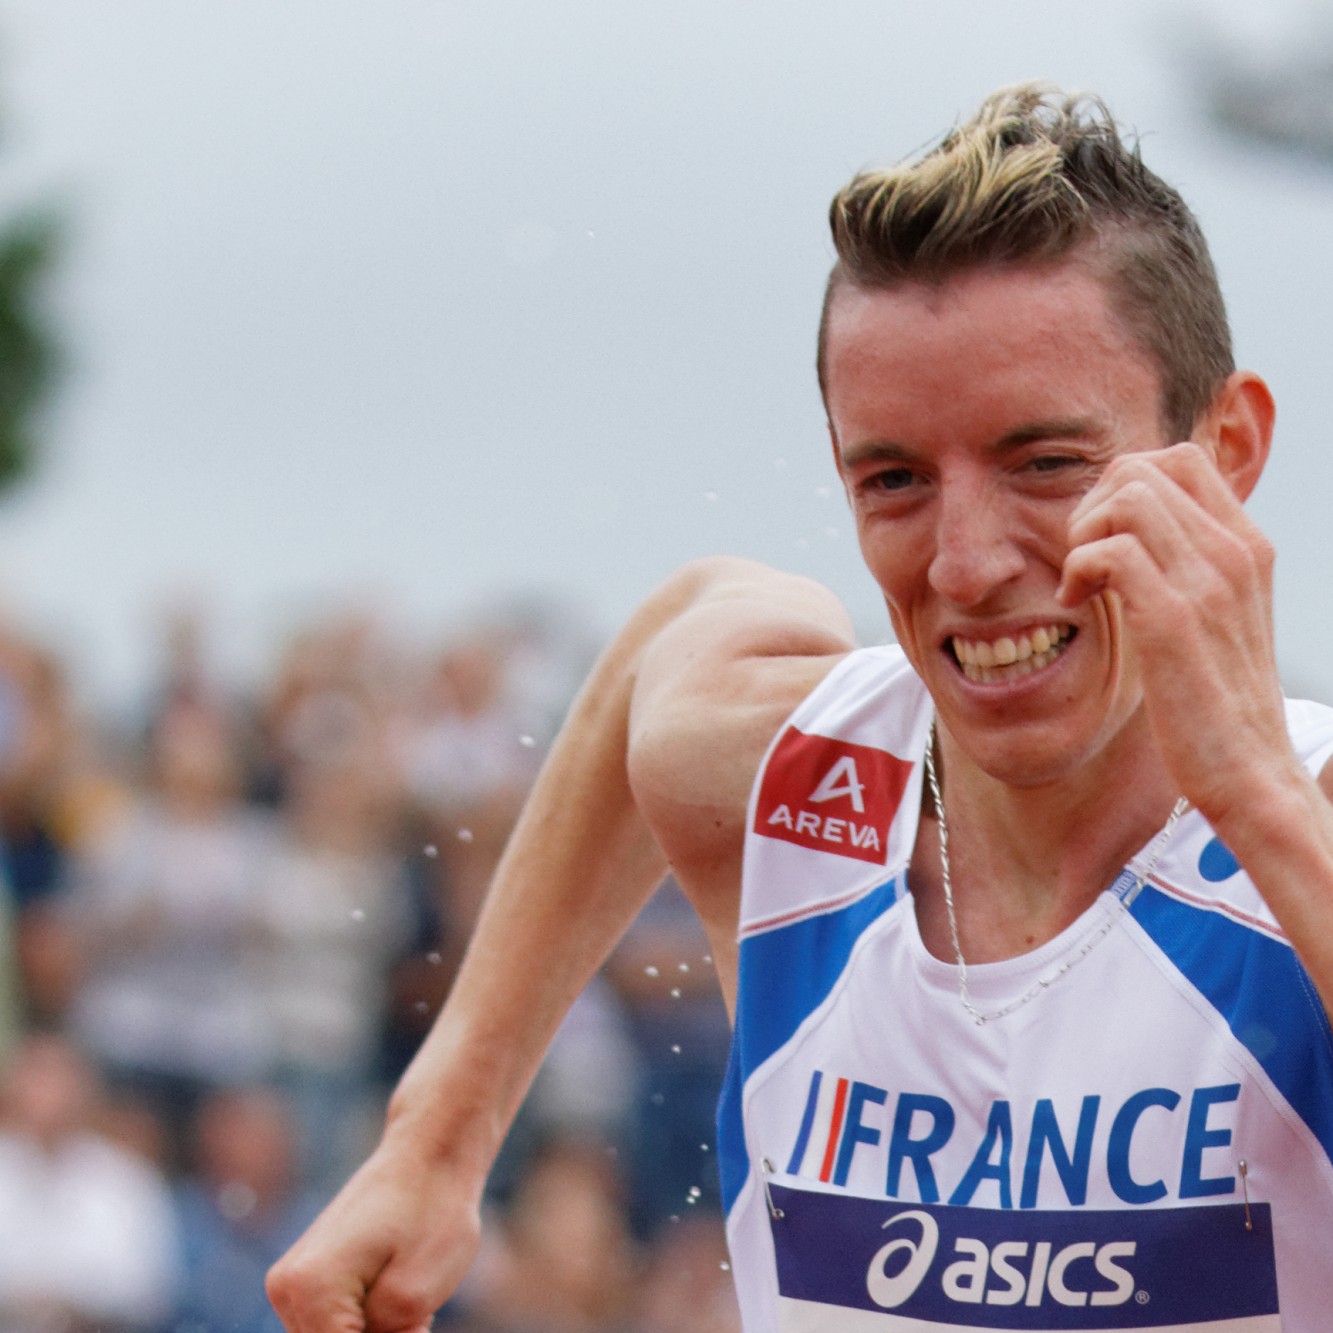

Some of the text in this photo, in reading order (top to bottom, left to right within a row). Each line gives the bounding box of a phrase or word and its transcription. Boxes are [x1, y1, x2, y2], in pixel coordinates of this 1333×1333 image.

[767, 804, 881, 851] AREVA
[833, 1081, 1240, 1209] FRANCE
[942, 1237, 1136, 1306] asics
